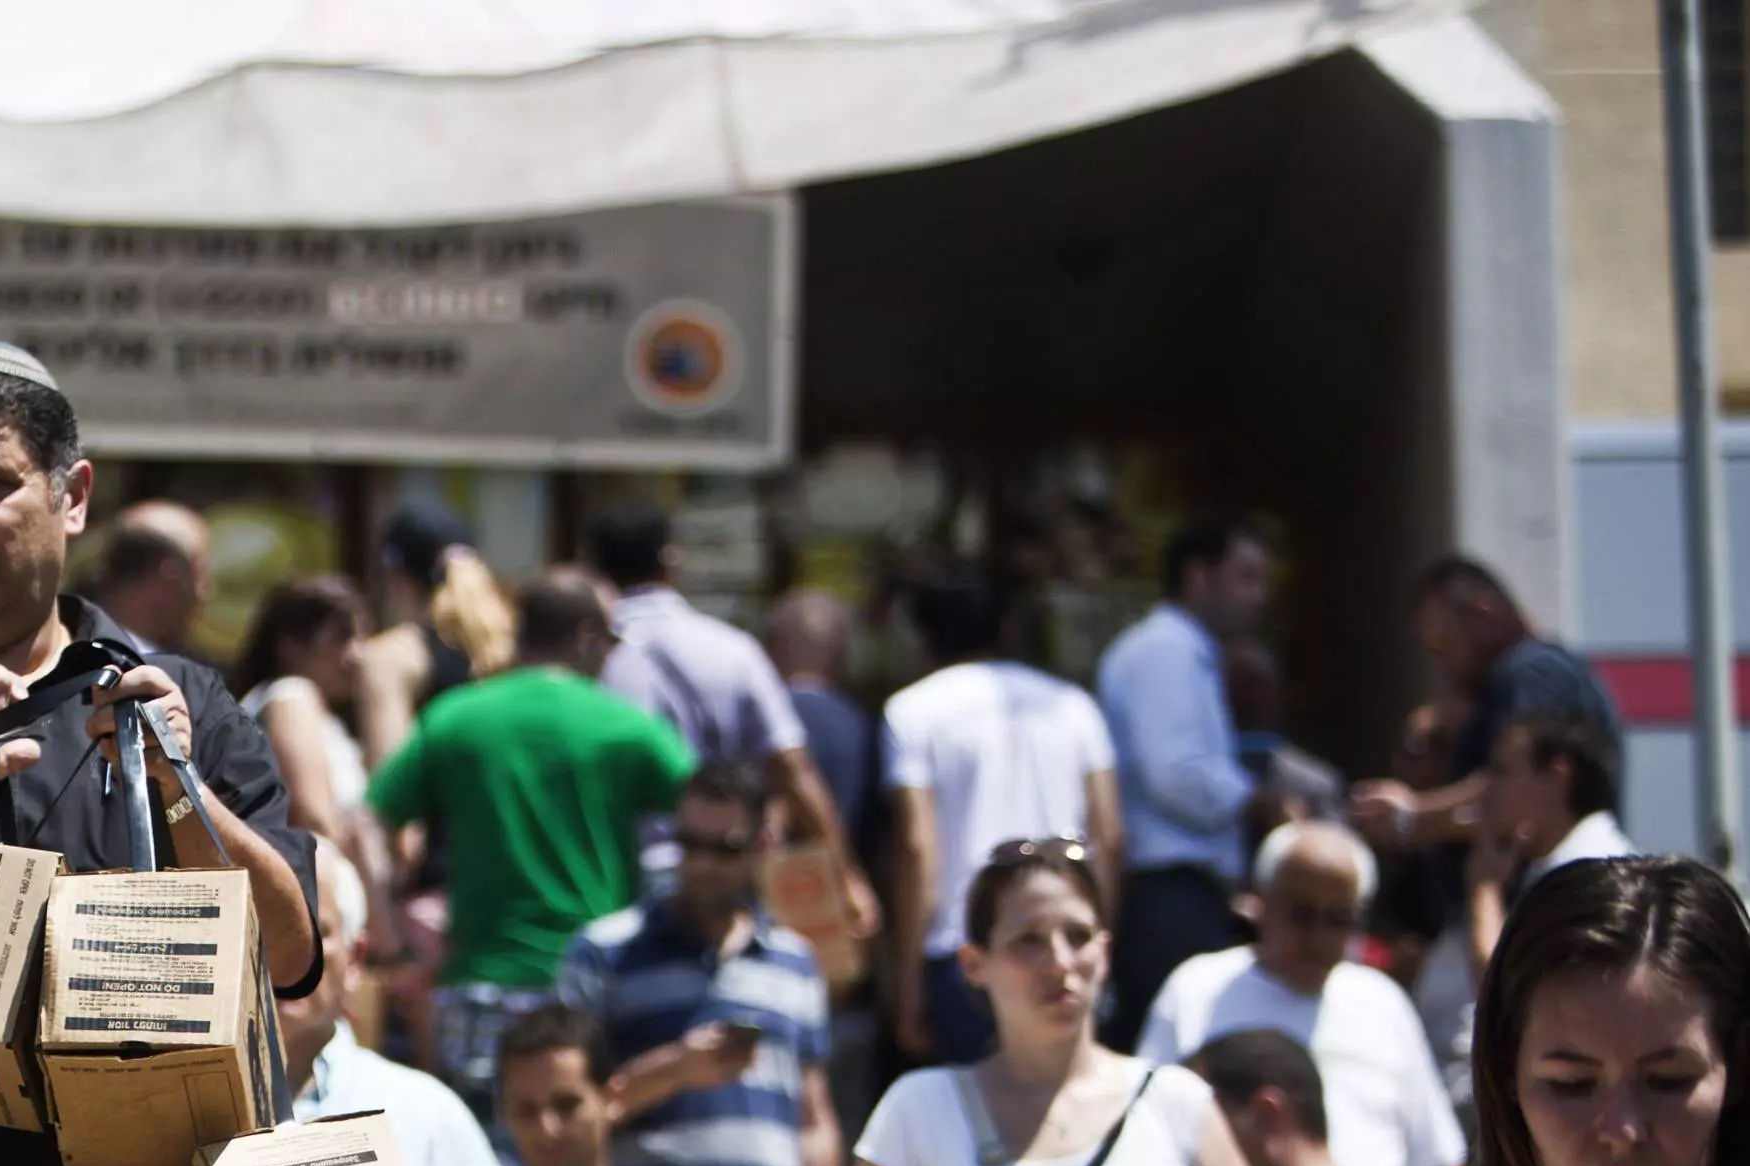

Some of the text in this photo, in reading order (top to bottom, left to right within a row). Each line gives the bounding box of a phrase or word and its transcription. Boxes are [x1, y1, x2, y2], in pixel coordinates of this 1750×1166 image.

[103, 983, 136, 992] OPEN!
[138, 984, 161, 992] NOT
[108, 1021, 130, 1029] אסור
